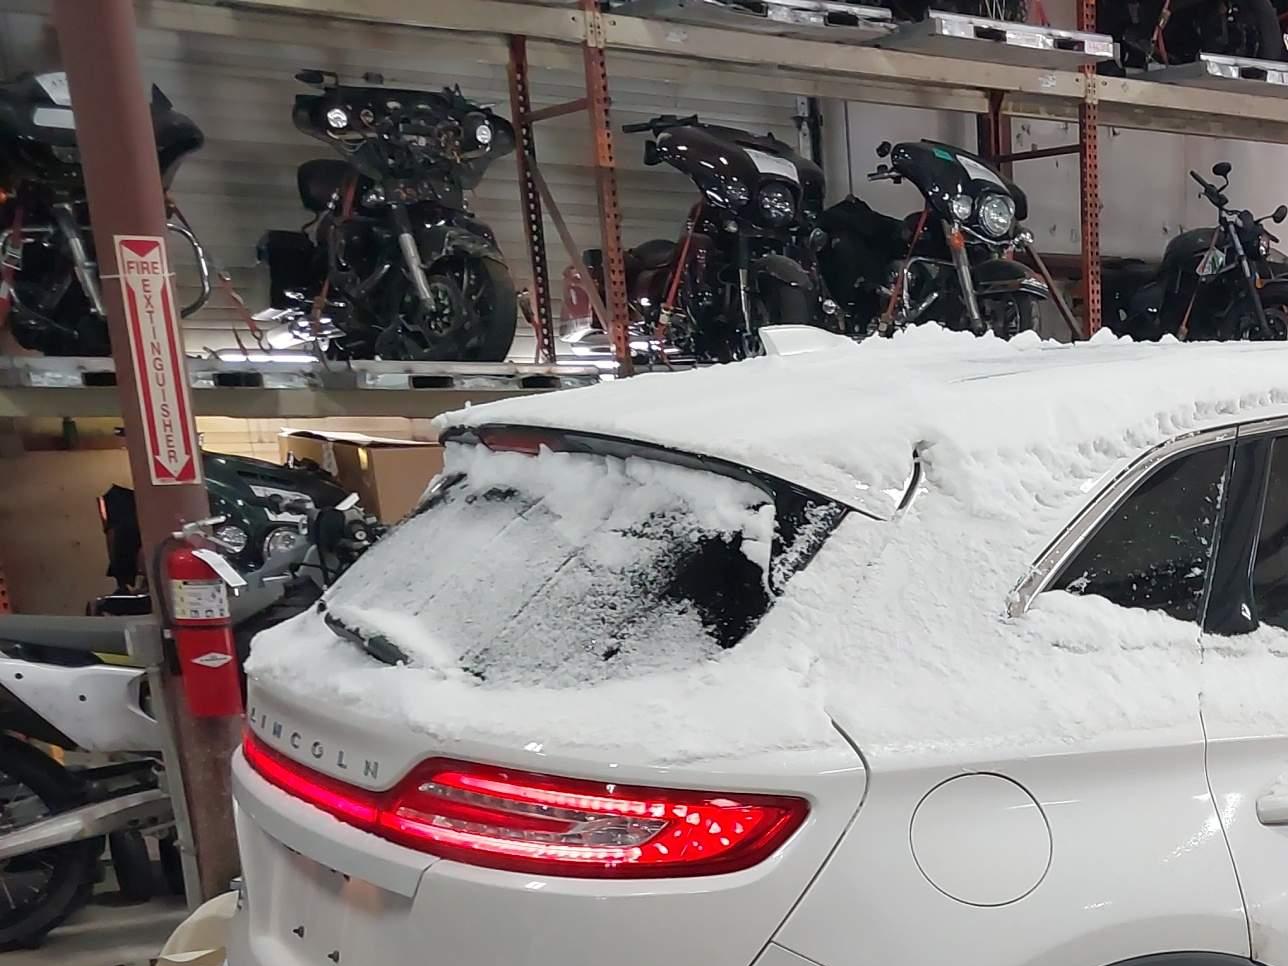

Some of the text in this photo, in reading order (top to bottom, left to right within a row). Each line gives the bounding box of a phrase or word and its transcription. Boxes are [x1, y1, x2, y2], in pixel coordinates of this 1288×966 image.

[127, 261, 160, 275] FIRE
[142, 279, 178, 463] EXTINGUISHER
[250, 707, 379, 779] LINCOLN
